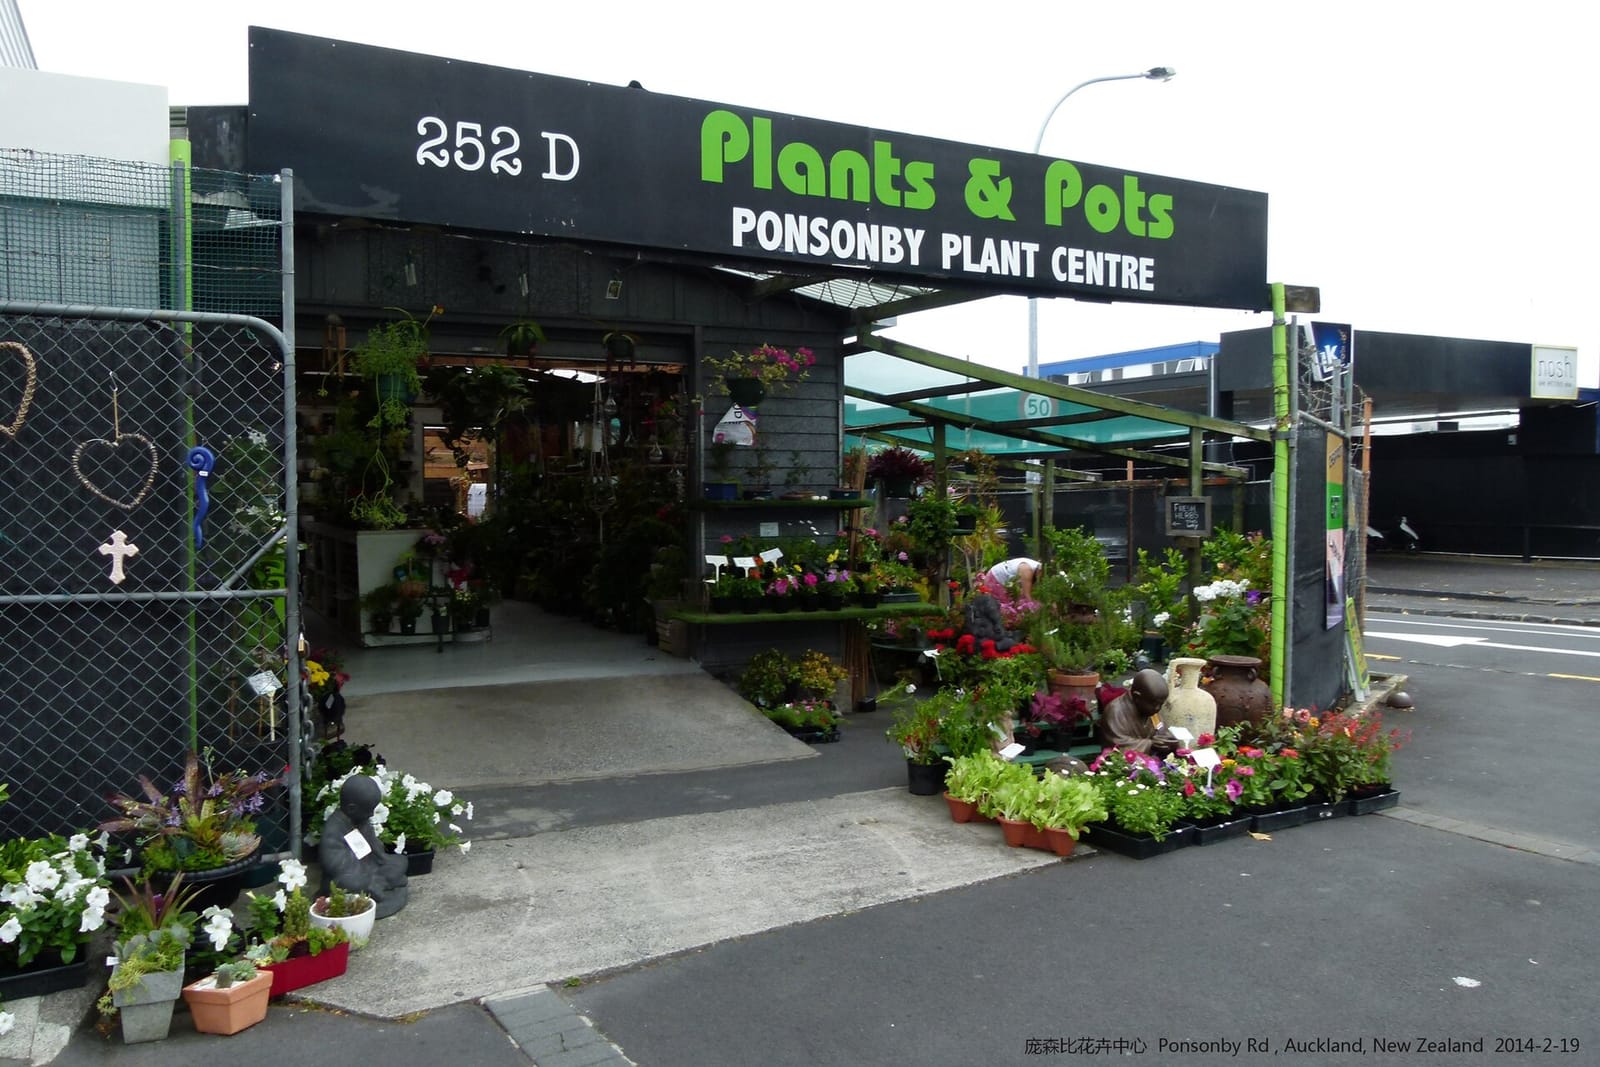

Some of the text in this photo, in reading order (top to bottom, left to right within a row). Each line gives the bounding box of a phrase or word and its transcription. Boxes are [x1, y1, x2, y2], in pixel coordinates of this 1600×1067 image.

[416, 116, 580, 181] 252 D
[701, 109, 1174, 239] Plants & Pots
[732, 206, 1155, 292] PONSONBY PLANT CENTRE
[1538, 354, 1574, 378] nosh
[1028, 398, 1050, 417] 50
